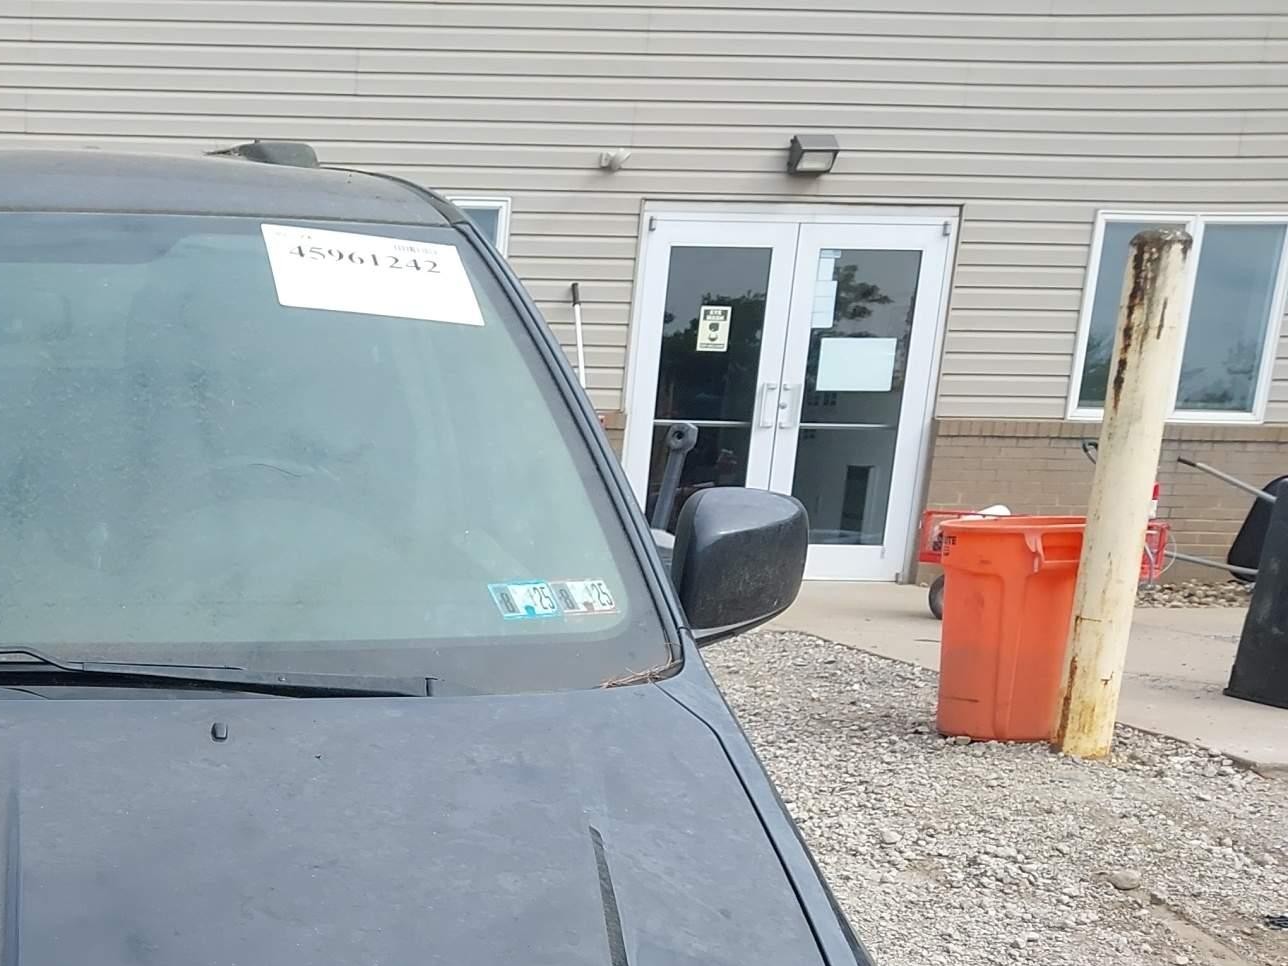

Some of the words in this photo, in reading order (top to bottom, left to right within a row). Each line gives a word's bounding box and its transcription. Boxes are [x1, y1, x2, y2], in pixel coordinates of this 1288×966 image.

[289, 244, 441, 274] 45961242
[500, 592, 516, 613] 8
[533, 586, 556, 610] 25
[559, 588, 575, 610] 8
[591, 582, 613, 606] 25
